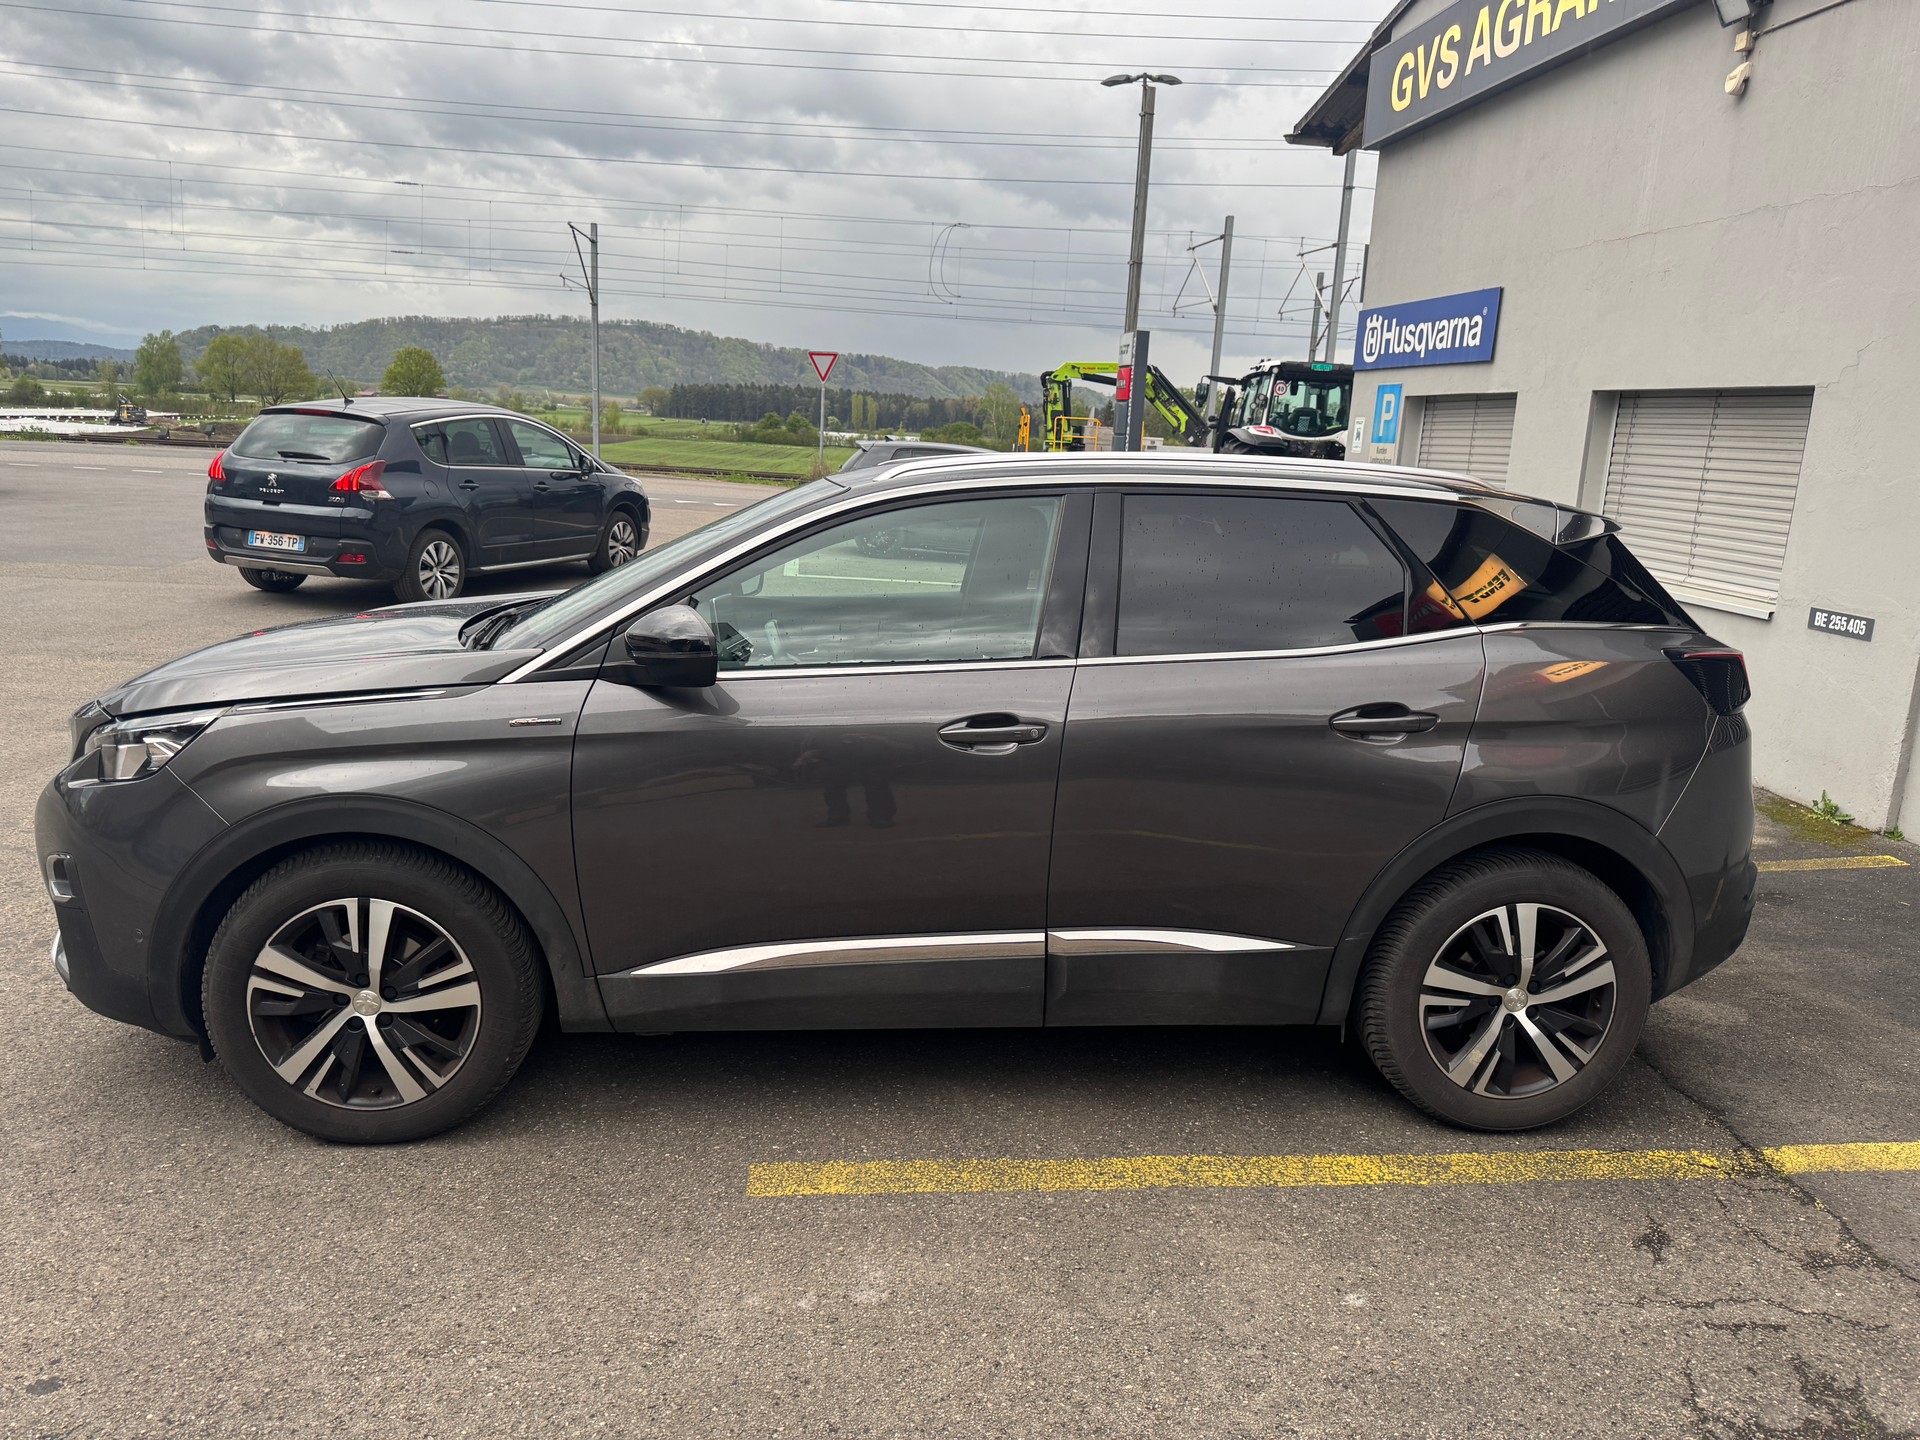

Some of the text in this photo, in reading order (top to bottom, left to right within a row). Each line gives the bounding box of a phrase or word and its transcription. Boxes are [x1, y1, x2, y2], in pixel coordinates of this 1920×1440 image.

[1391, 0, 1615, 112] GVS AGRA
[1380, 314, 1484, 358] Husqvarna
[1378, 393, 1396, 437] P
[1814, 611, 1829, 628] BE
